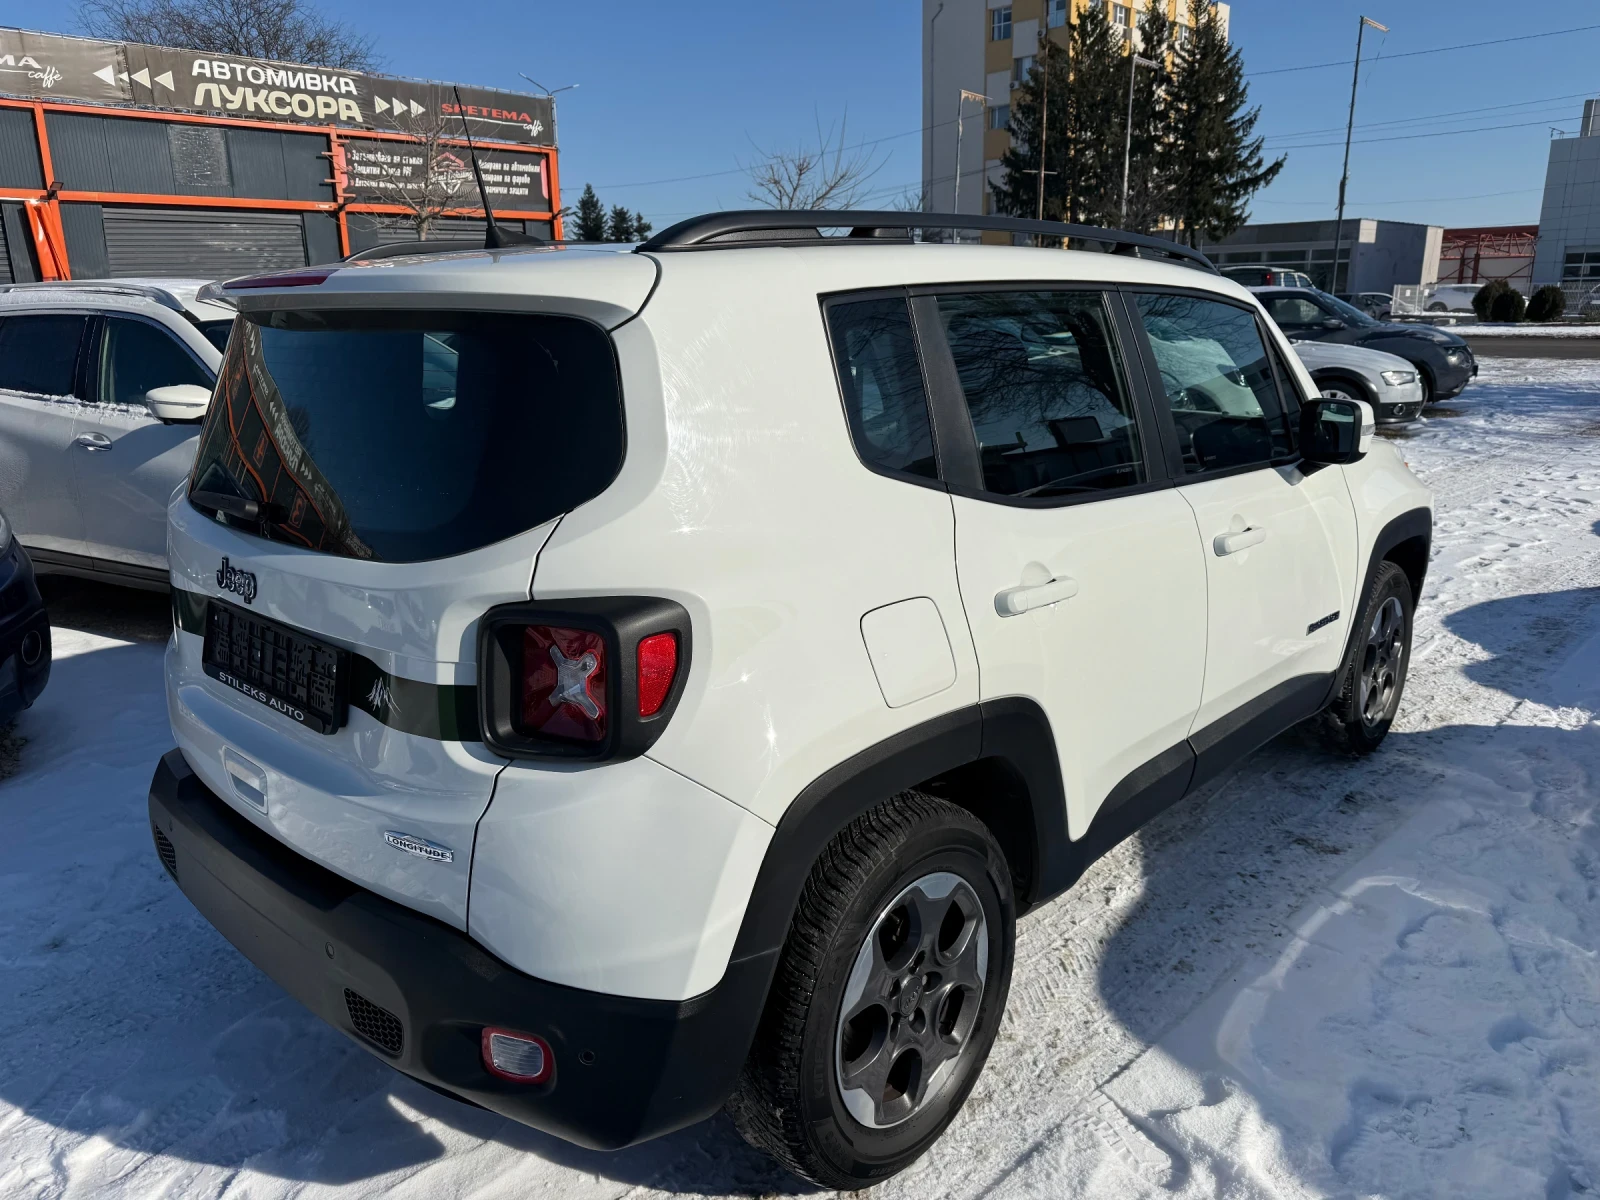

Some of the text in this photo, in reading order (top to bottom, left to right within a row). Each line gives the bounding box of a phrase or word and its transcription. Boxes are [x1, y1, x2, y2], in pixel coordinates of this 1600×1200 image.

[27, 65, 63, 88] caffè
[191, 59, 358, 96] АВТОМИВКА
[193, 82, 364, 123] ЛУКСОРА
[441, 103, 532, 122] SPETEMA
[503, 163, 510, 172] на
[511, 161, 541, 173] автомобили
[504, 174, 511, 183] на
[511, 173, 531, 186] фарове
[216, 556, 258, 604] Jeep
[219, 671, 304, 721] STILEKS AUTO
[387, 834, 448, 859] LONGITUDE
